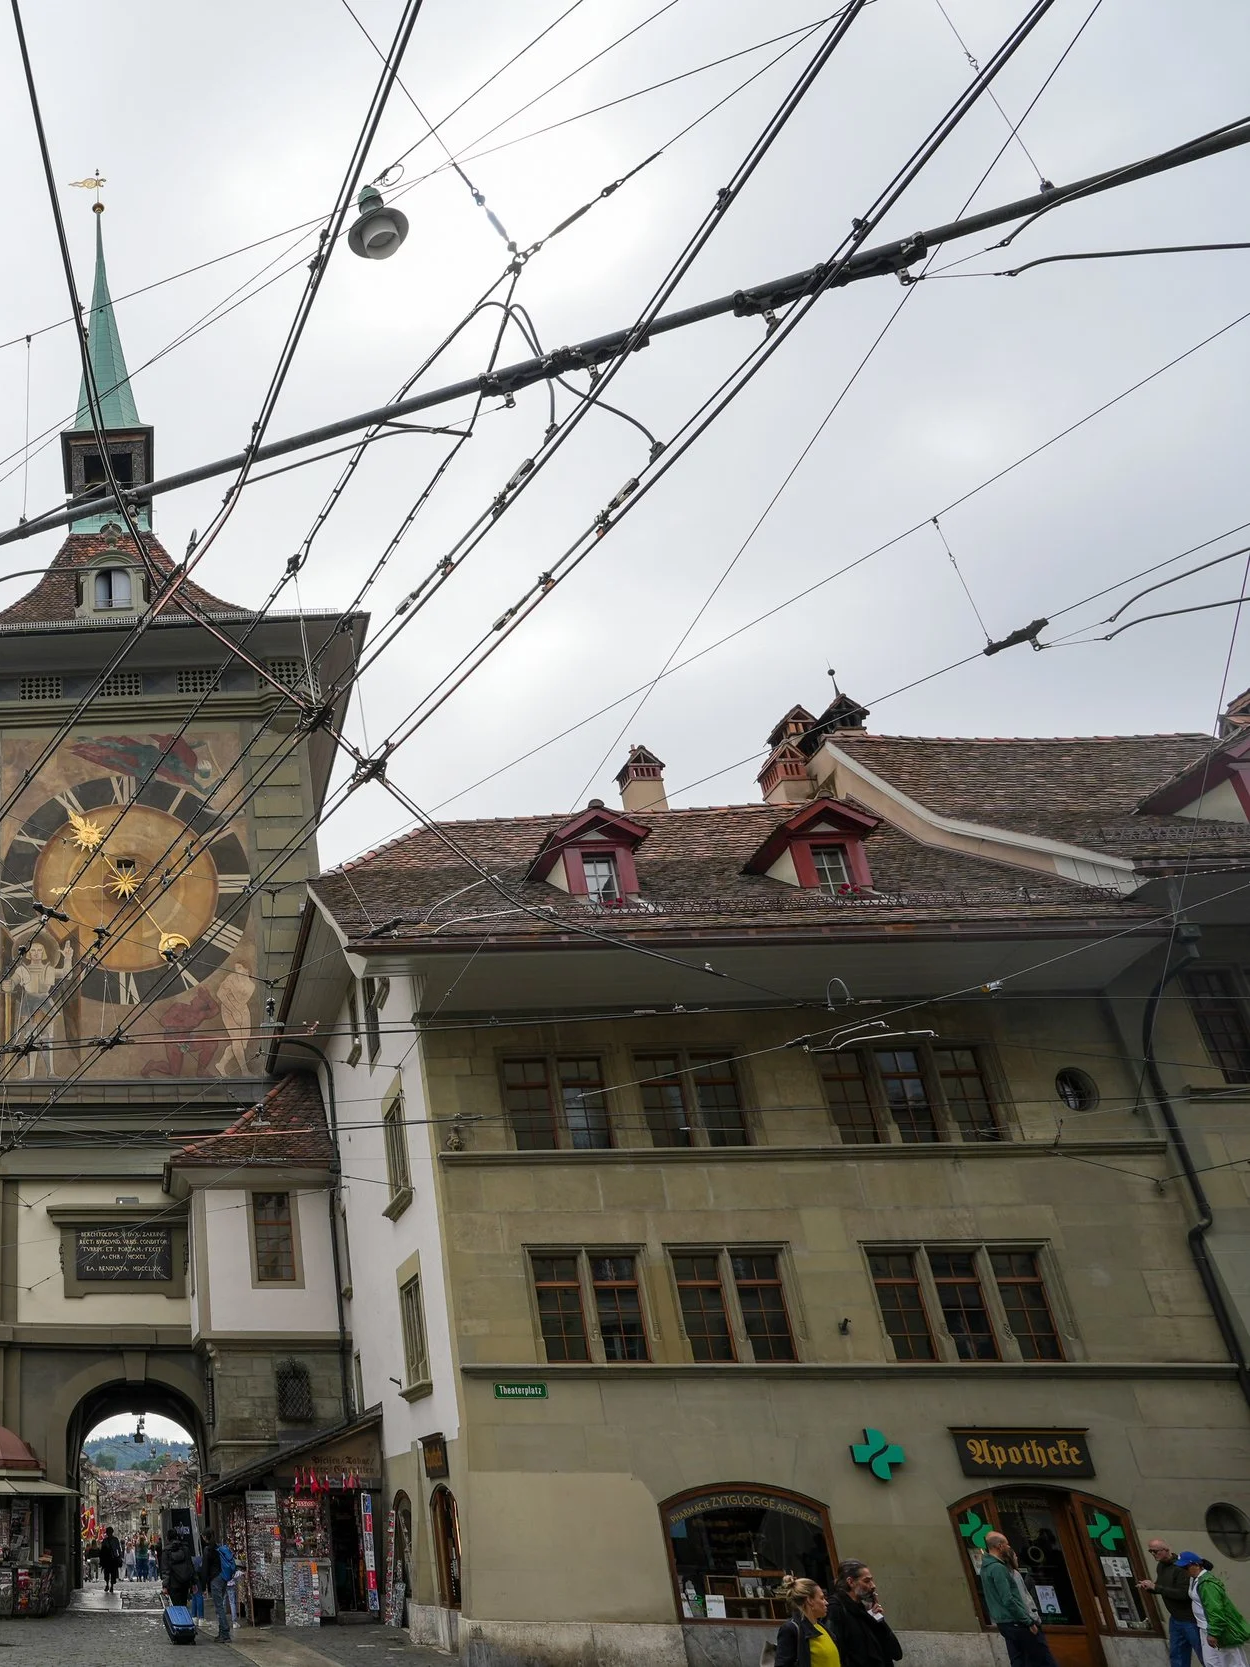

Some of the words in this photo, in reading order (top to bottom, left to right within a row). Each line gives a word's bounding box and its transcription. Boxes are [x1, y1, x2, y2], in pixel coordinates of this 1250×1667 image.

[499, 1385, 542, 1396] Theaterplatz
[966, 1439, 1084, 1470] Apotheke
[670, 1501, 710, 1523] PHARMACIE
[710, 1494, 776, 1510] ZYTGLOGGE
[776, 1503, 820, 1525] APOTHEKE
